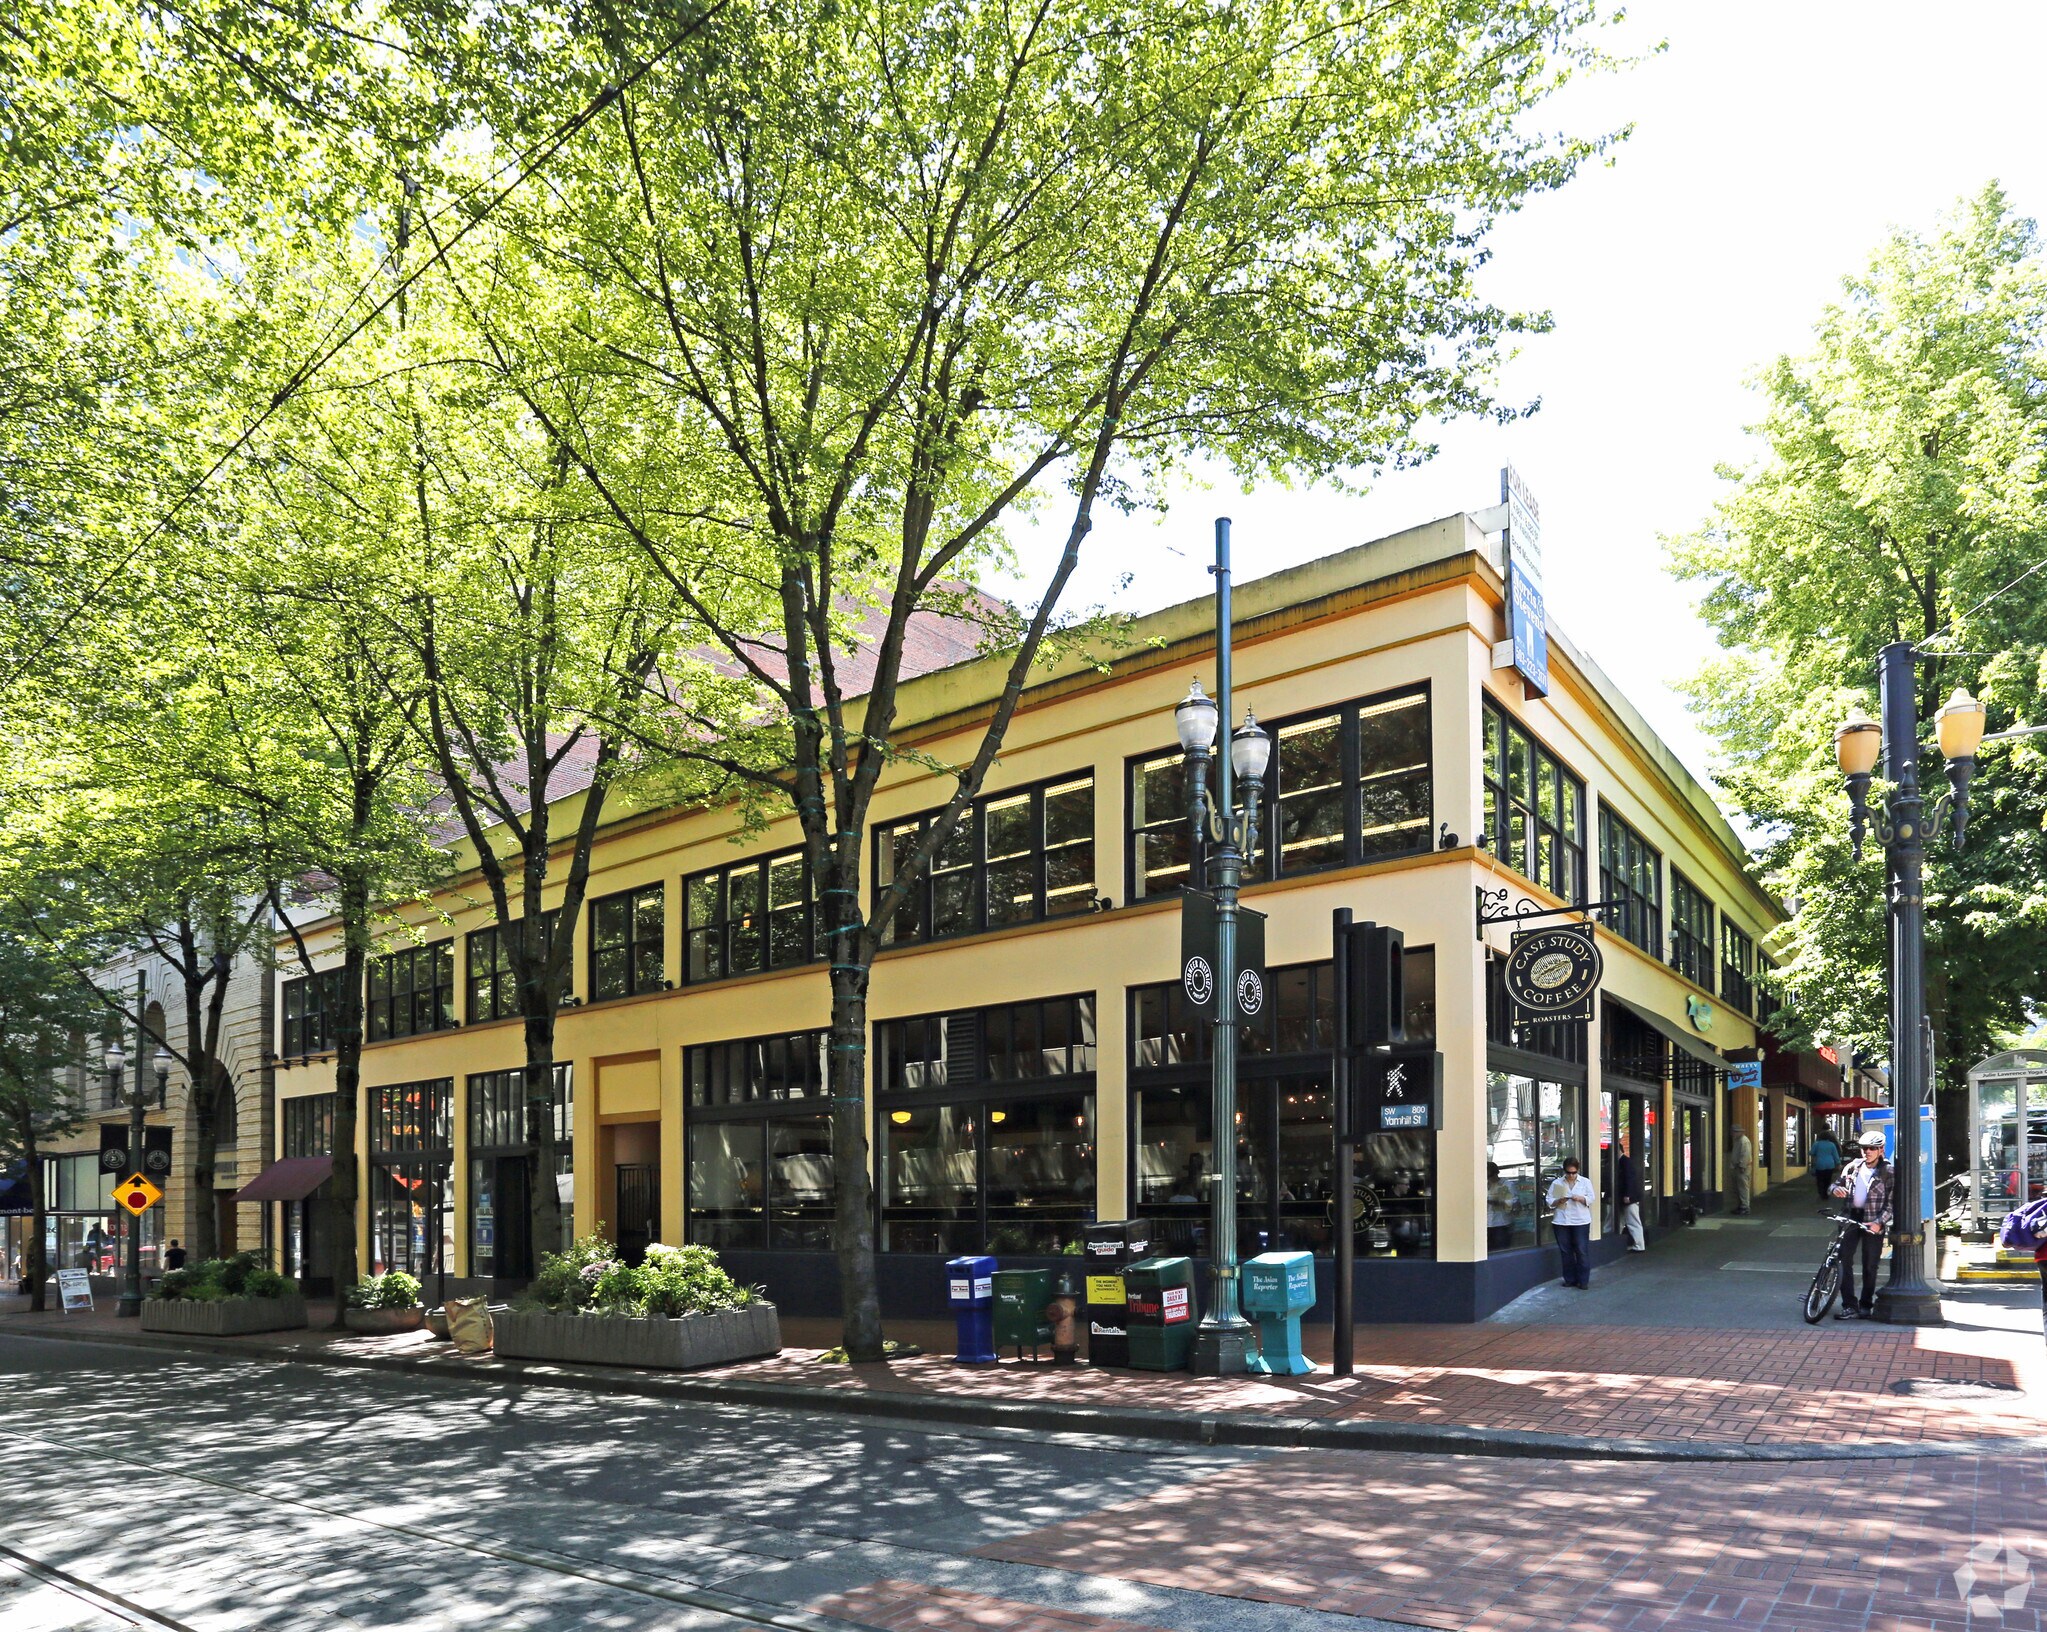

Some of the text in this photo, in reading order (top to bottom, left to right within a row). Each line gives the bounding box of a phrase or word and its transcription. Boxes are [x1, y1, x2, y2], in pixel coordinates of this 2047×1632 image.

[1512, 566, 1537, 610] Norris
[1513, 586, 1545, 634] Stevens
[1515, 936, 1591, 970] CASE STUDY
[1523, 983, 1582, 1004] COFFEE
[1533, 1014, 1571, 1023] ROASTERS
[1384, 1106, 1426, 1115] SW 800
[1384, 1115, 1422, 1126] Yamhill St
[1252, 1275, 1263, 1283] The
[1253, 1283, 1279, 1291] Reporter
[1129, 1300, 1159, 1312] Tribune
